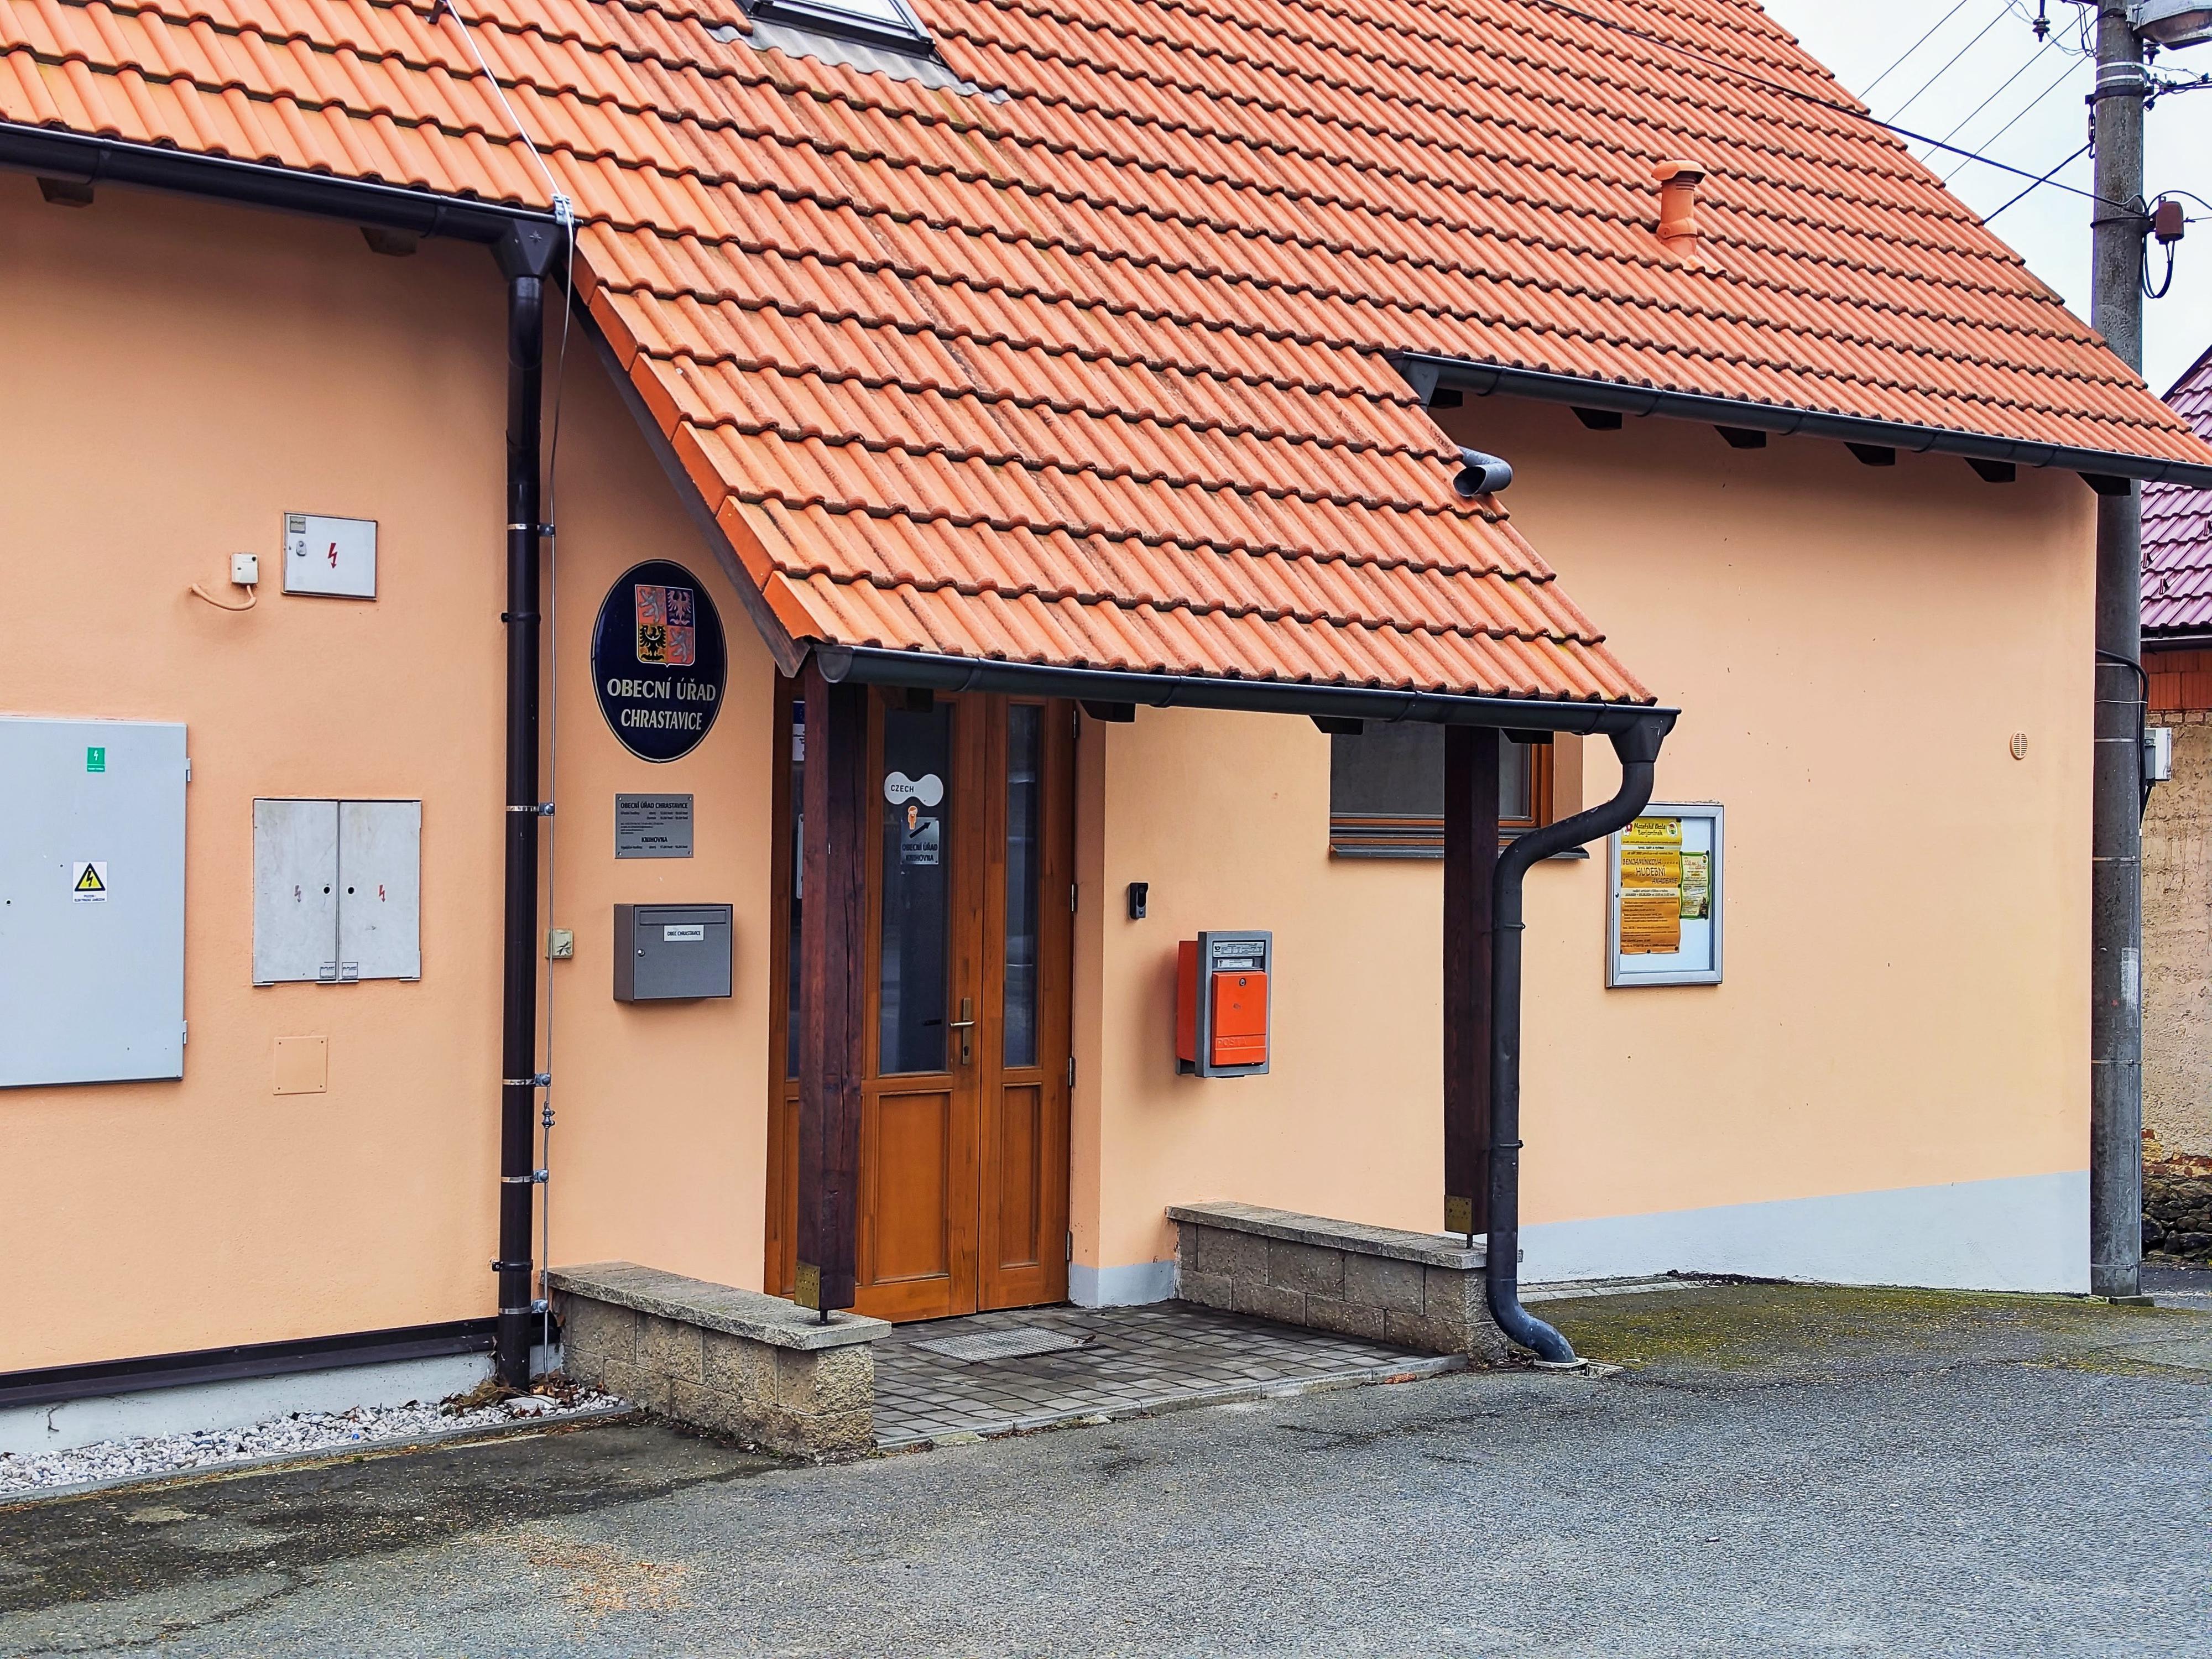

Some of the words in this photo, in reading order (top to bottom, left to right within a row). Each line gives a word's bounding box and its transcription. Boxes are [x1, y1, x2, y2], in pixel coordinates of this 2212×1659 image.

[607, 676, 671, 699] OBECNÍ
[676, 677, 716, 701] ÚŘAD
[620, 708, 703, 730] CHRASTAVICE
[890, 784, 914, 793] CZECH
[902, 842, 922, 851] OBECNÍ
[923, 842, 938, 851] ÚŘAD
[1636, 864, 1666, 877] HUDEBNÍ
